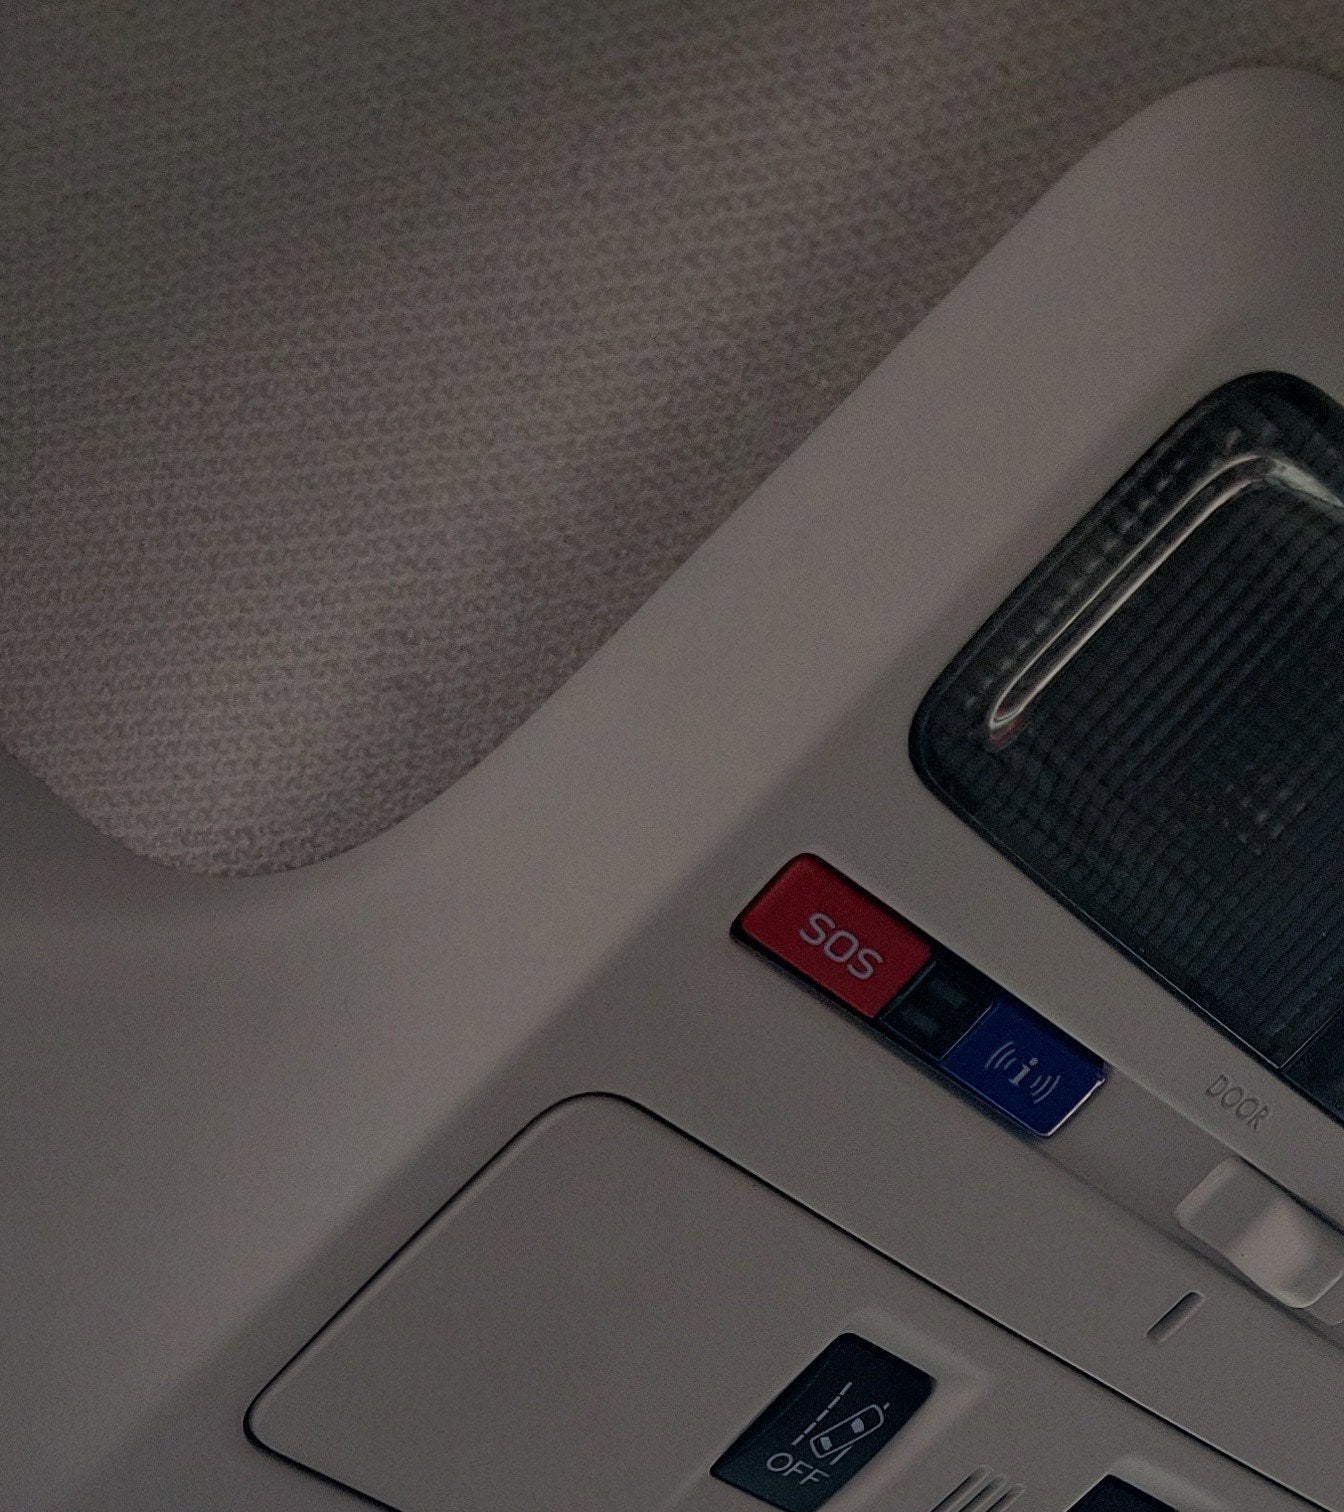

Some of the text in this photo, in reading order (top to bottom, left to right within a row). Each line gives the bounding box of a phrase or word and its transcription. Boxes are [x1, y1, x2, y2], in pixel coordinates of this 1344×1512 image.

[799, 911, 884, 981] SOS
[1205, 1074, 1271, 1130] DOOR
[766, 1452, 830, 1487] OFF
